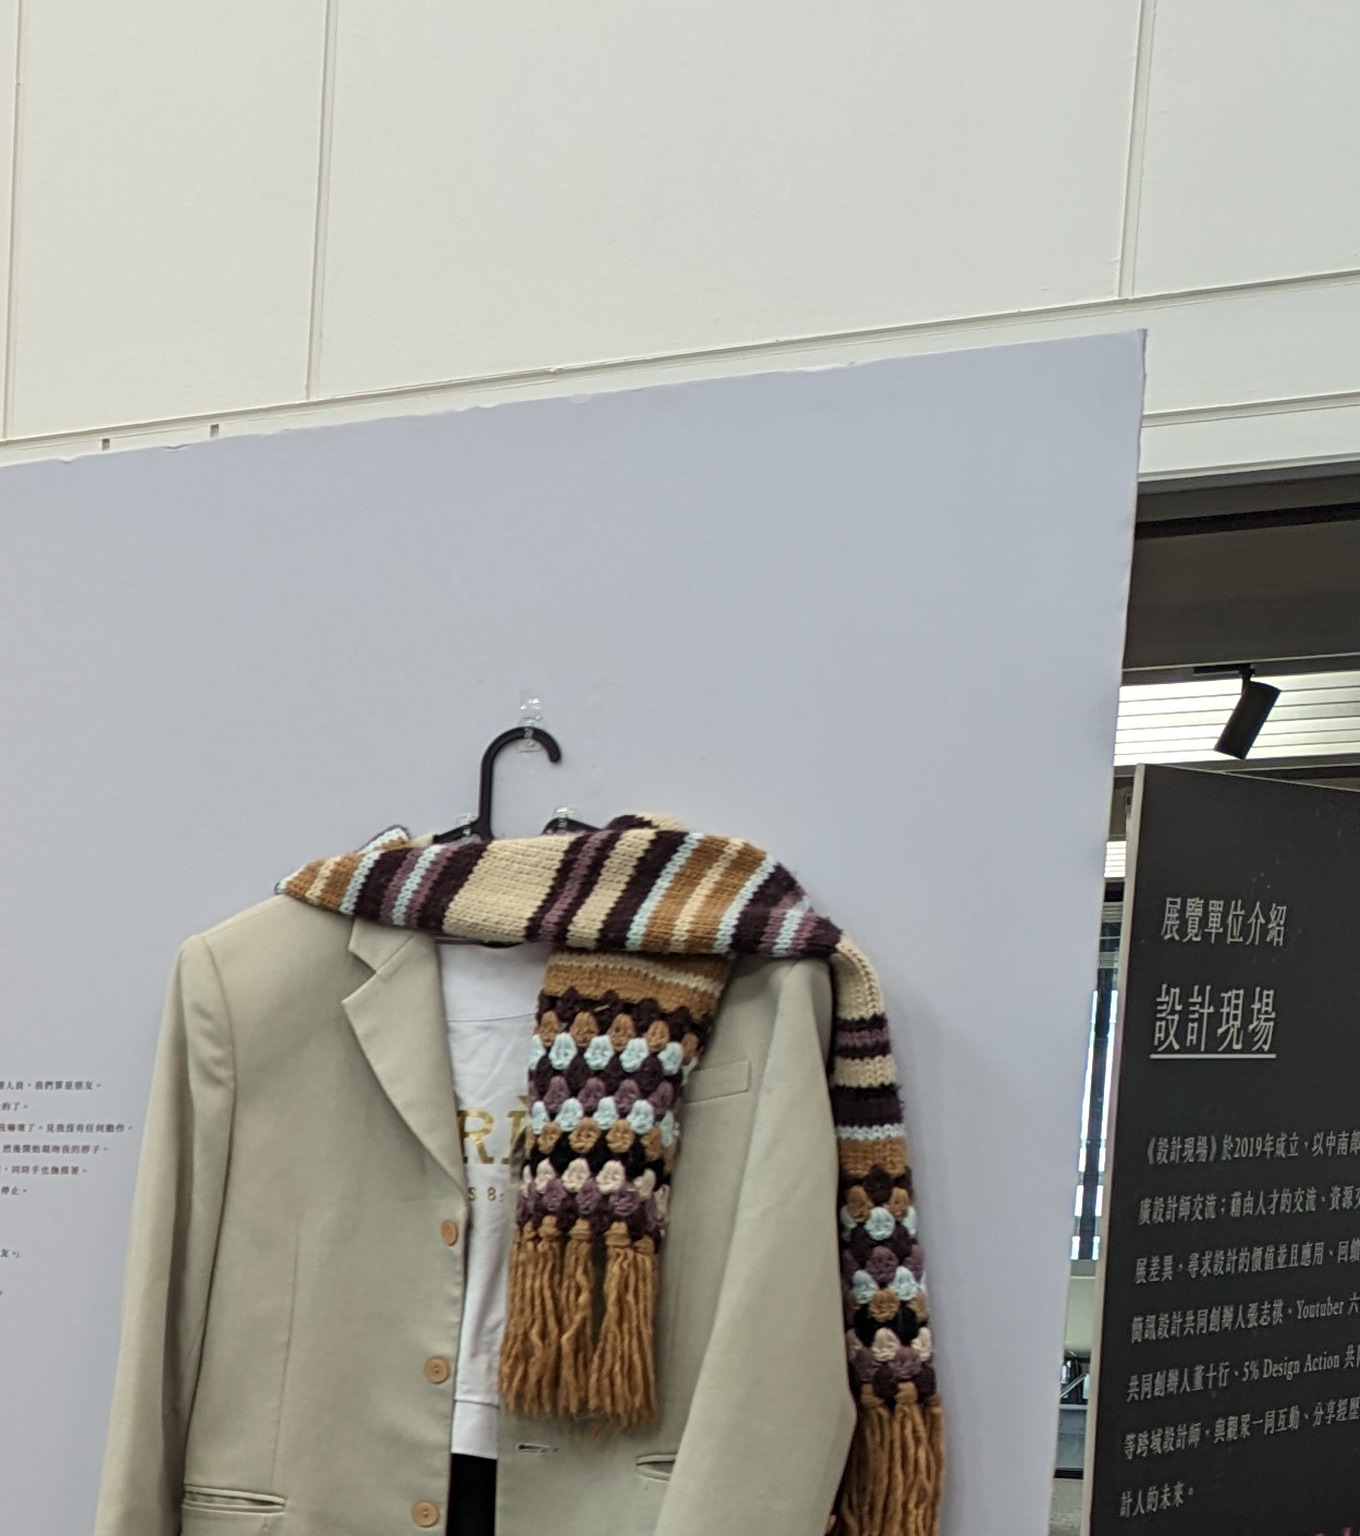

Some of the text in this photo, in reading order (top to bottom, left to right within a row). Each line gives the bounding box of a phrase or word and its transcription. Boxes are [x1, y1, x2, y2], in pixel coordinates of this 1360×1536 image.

[1160, 896, 1288, 947] 展覽單位介紹
[1153, 983, 1276, 1052] 設計現場
[1263, 1358, 1300, 1381] Design
[1305, 1351, 1340, 1373] Action
